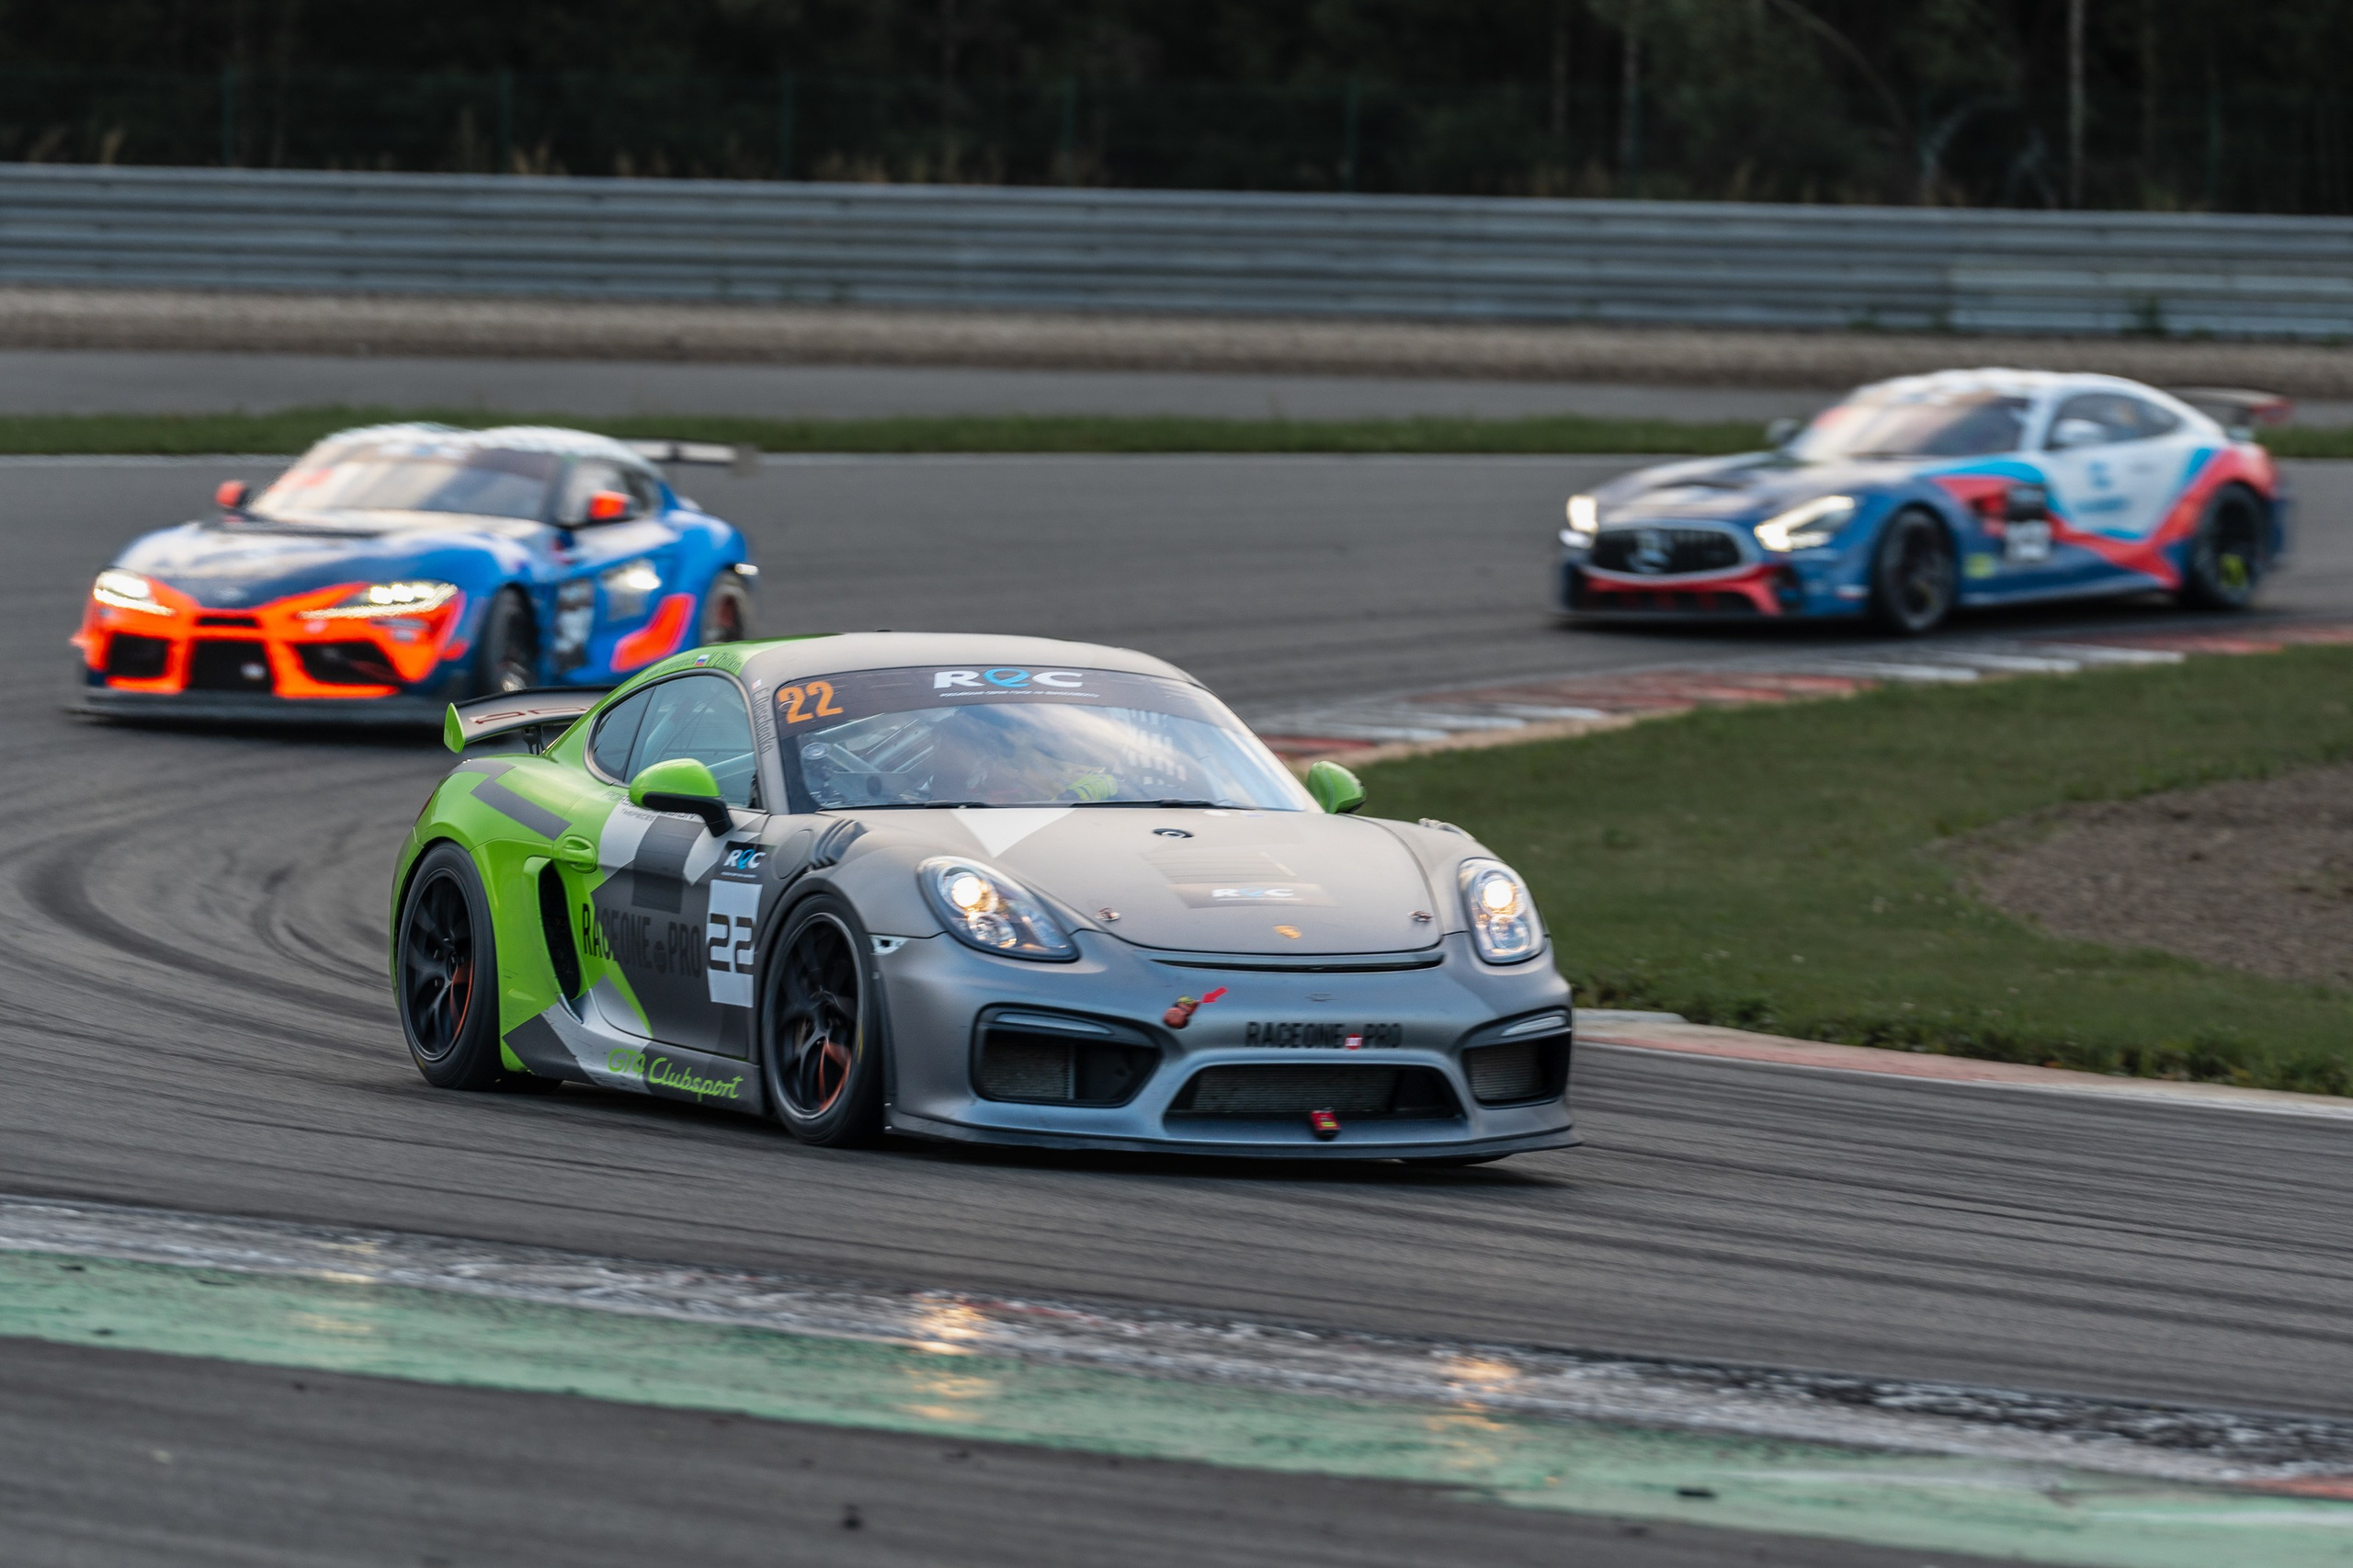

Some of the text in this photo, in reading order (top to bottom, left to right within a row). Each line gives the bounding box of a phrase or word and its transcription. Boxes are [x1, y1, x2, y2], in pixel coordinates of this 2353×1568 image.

[777, 680, 845, 724] 22
[583, 903, 701, 978] RACEONE PRO
[707, 913, 755, 974] 22
[1245, 1021, 1403, 1050] RACEONE PRO
[648, 1057, 744, 1103] Clubsport
